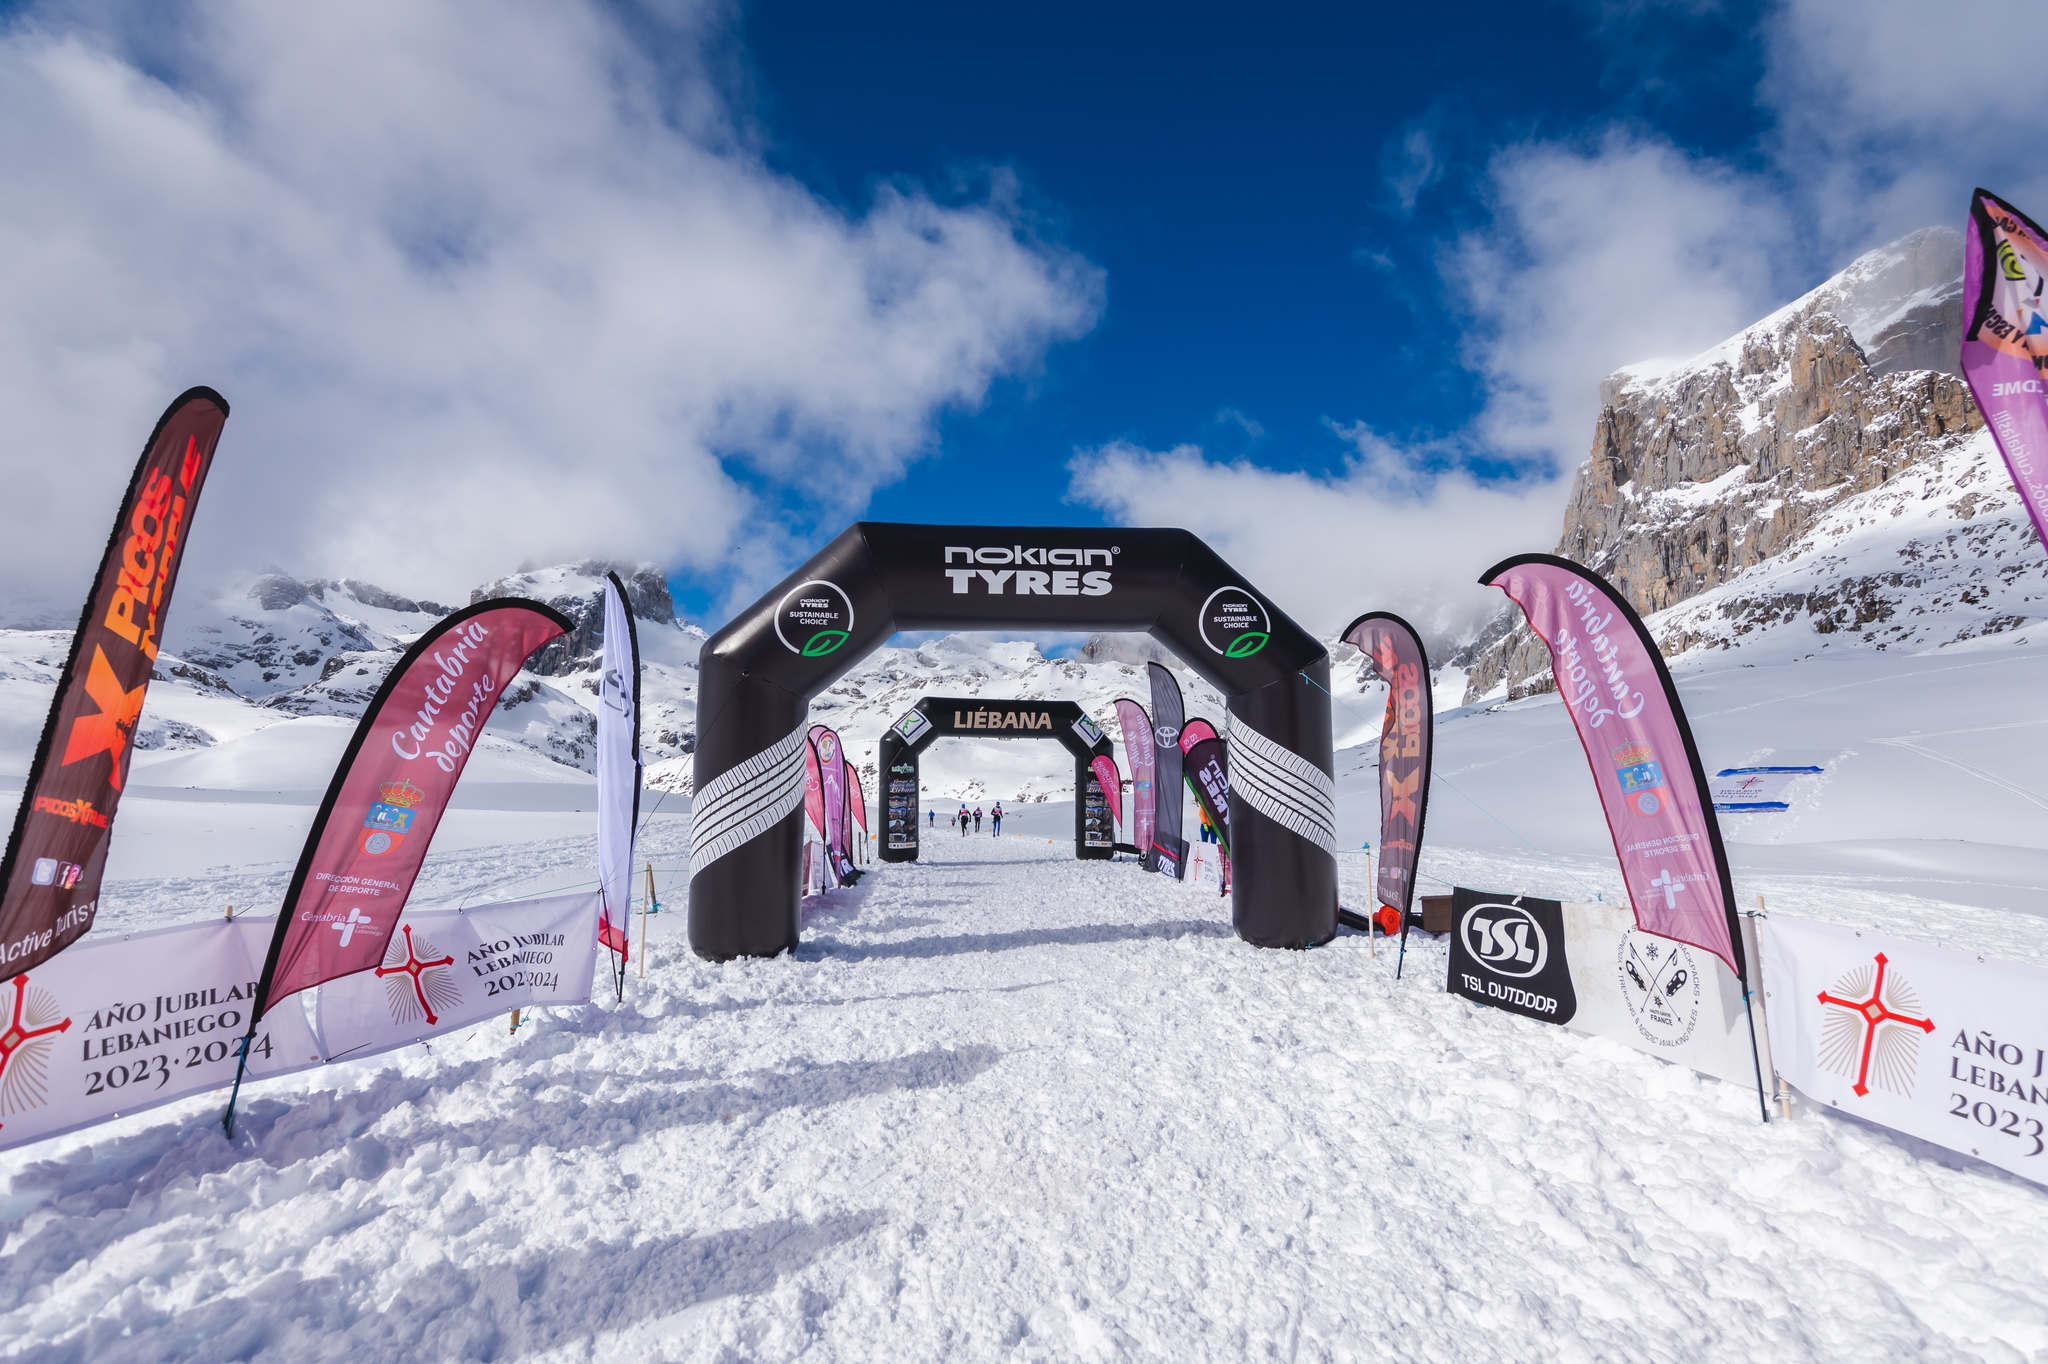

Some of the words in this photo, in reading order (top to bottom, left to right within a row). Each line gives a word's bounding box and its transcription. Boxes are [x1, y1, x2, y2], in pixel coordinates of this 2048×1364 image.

[104, 467, 172, 645] PICOS
[945, 569, 1113, 596] TYRES
[789, 611, 839, 619] SUSTAINABLE
[392, 621, 489, 760] Cantabria
[425, 674, 495, 772] deporte
[954, 706, 1053, 729] LIÉBANA
[328, 884, 340, 892] DE
[340, 885, 381, 896] DEPORTE
[360, 878, 401, 891] GENERAL
[467, 940, 511, 965] AÑO
[512, 933, 565, 948] JUBILAR
[1472, 917, 1535, 964] TSL
[1461, 973, 1486, 994] TSL
[1488, 981, 1558, 1015] OUTDOOR
[83, 1001, 147, 1033] AÑO
[1650, 1013, 1673, 1026] FRANCE
[82, 1010, 241, 1062] LEBANIEGO
[1951, 1028, 2024, 1066] AÑO
